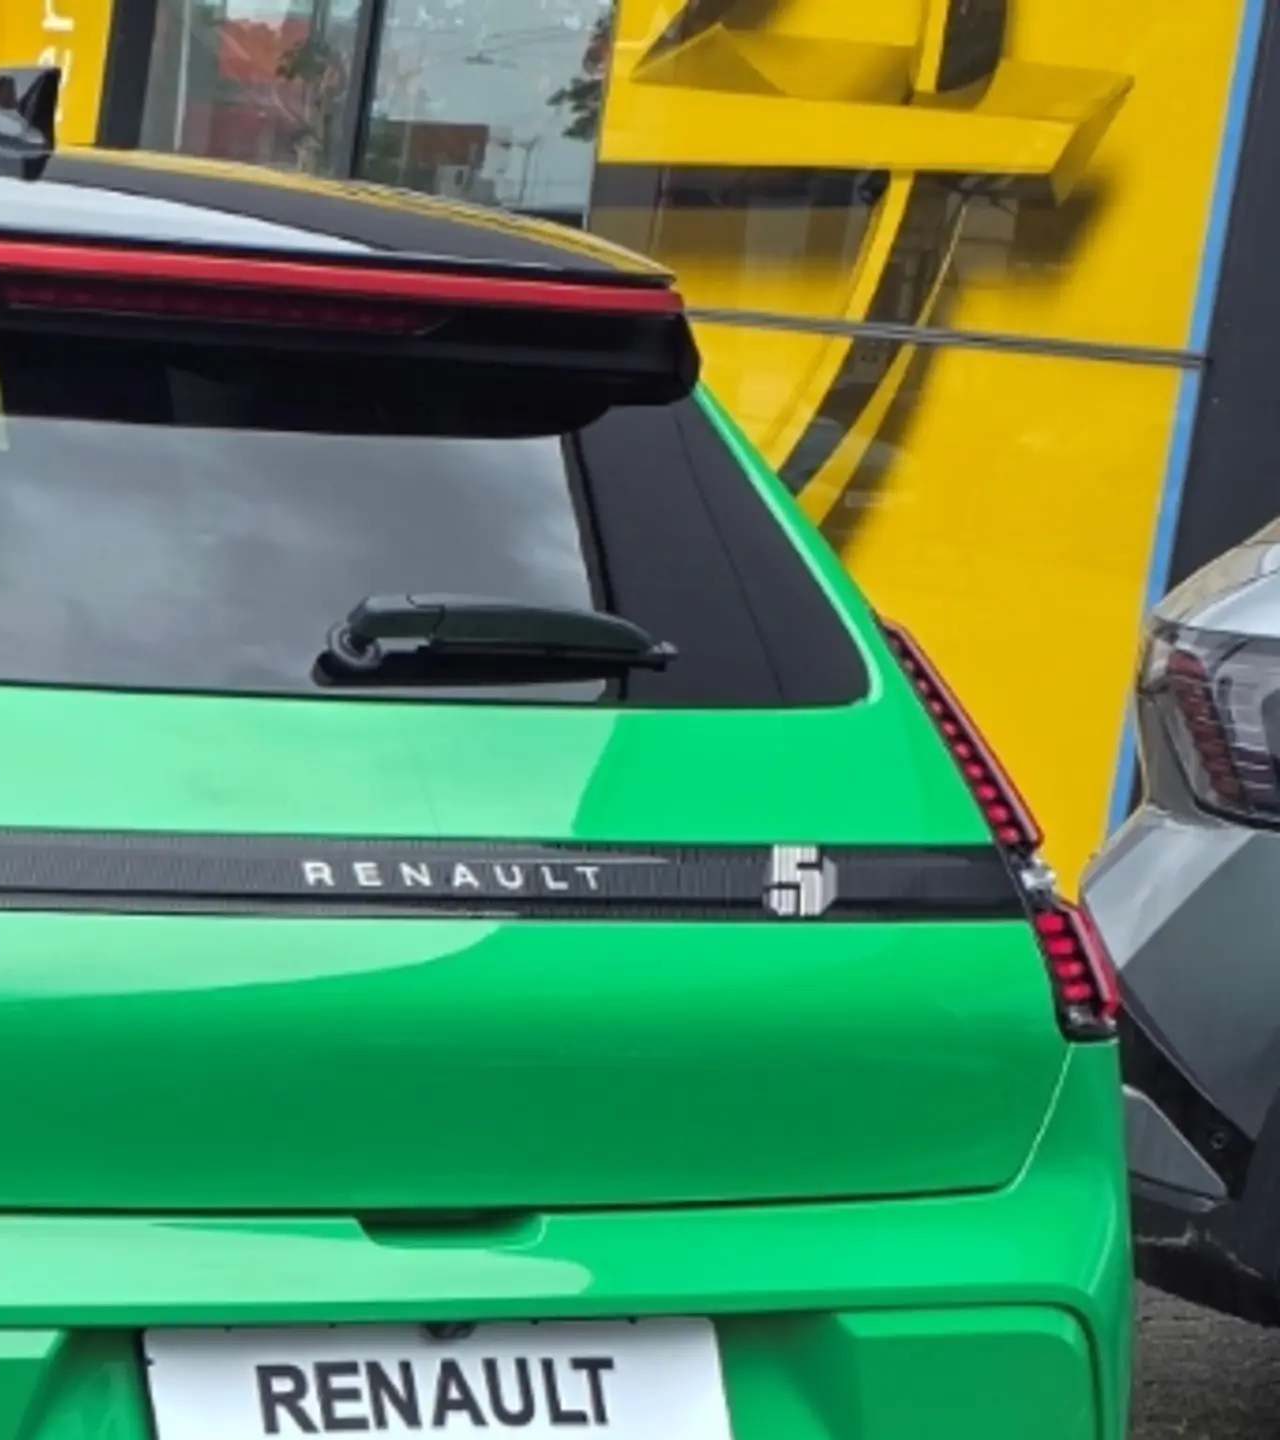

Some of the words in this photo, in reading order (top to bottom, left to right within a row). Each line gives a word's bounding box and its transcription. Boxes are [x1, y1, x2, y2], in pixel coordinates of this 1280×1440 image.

[302, 861, 601, 890] RENAULT
[764, 844, 836, 916] 5
[256, 1357, 614, 1434] RENAULT
